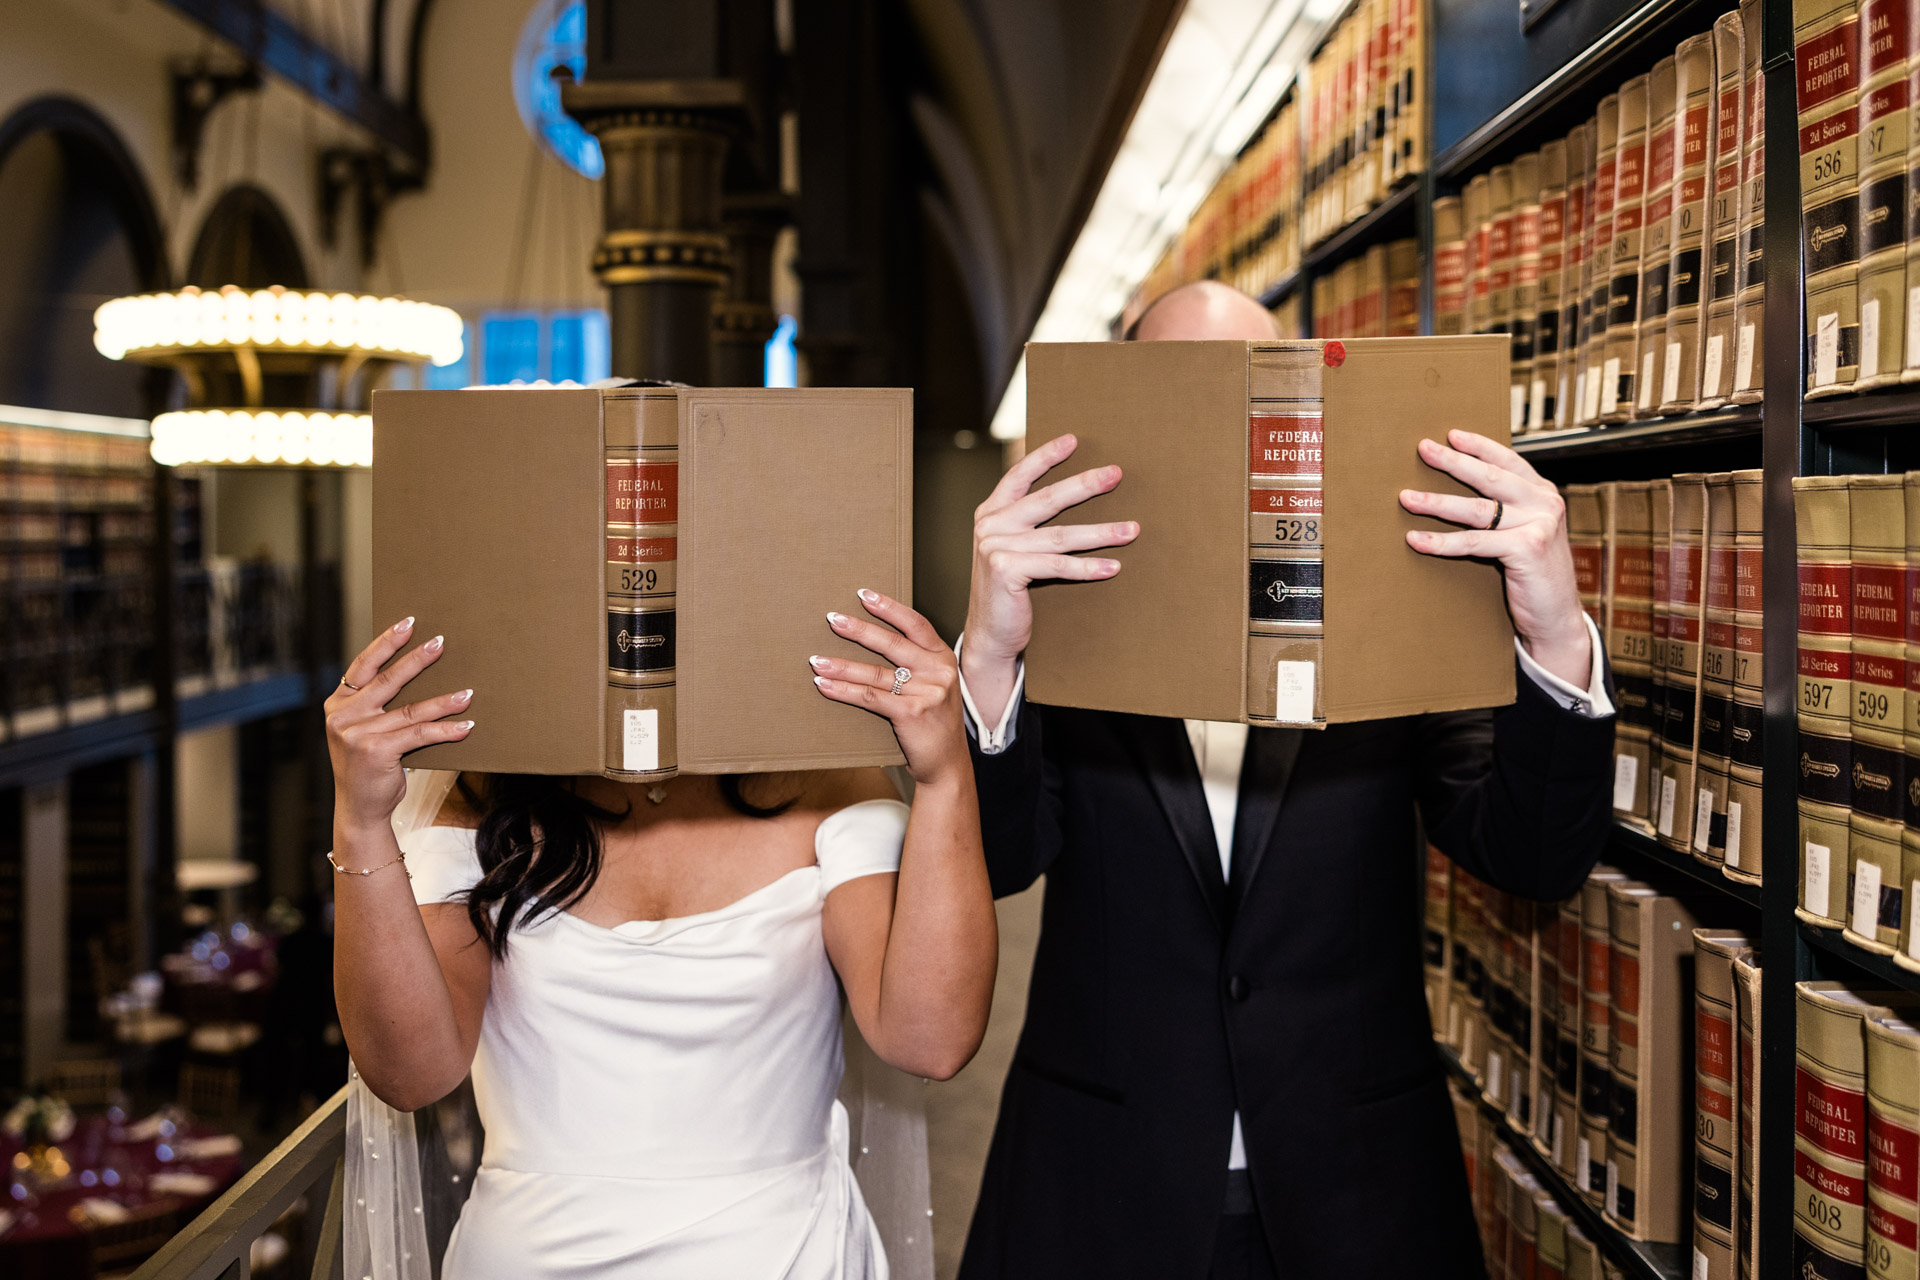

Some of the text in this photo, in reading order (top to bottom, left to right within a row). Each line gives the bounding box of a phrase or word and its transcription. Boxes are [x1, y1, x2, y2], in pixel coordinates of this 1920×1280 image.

[1808, 43, 1846, 72] FEDERAL
[1805, 62, 1850, 93] REPORTER
[1810, 122, 1847, 144] 2d Series
[1814, 150, 1841, 181] 586
[1264, 449, 1322, 461] REPORTE
[618, 480, 664, 491] FEDERAL
[616, 498, 666, 510] REPORTER
[1269, 496, 1283, 506] 2d
[1275, 520, 1318, 542] 528
[618, 545, 663, 556] 2d Series
[621, 568, 657, 592] 529
[1856, 583, 1894, 601] FEDERAL
[1853, 605, 1897, 623] REPORTER
[1706, 652, 1722, 675] 516
[1735, 657, 1748, 680] 17
[1801, 656, 1839, 672] 2d Series
[1855, 660, 1894, 679] 2d Series
[1804, 682, 1833, 709] 597
[1858, 691, 1888, 720] 599
[1807, 1091, 1851, 1123] FEDERAL
[1805, 1110, 1857, 1144] REPORTER
[1806, 1164, 1850, 1196] 2d Series
[1808, 1194, 1842, 1231] 608
